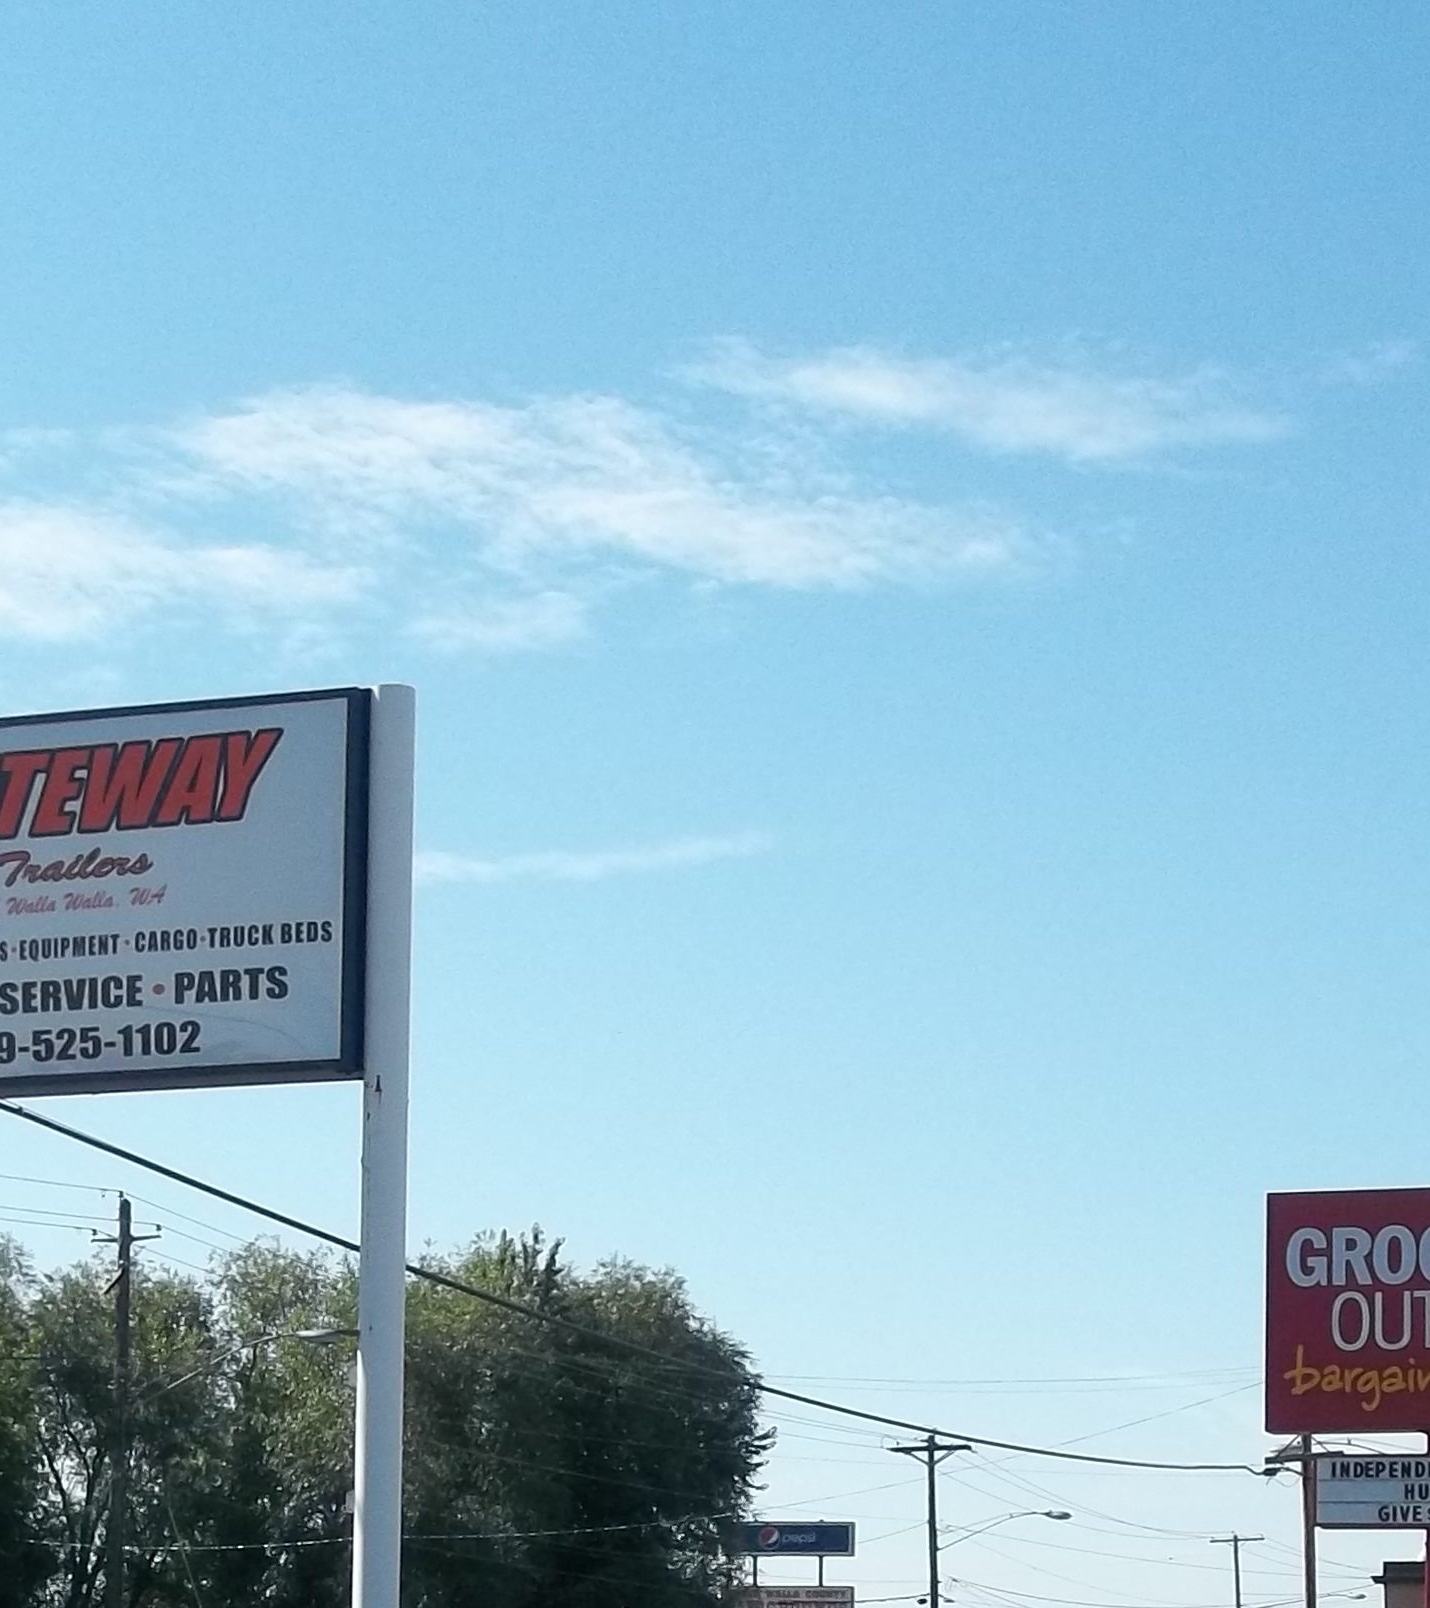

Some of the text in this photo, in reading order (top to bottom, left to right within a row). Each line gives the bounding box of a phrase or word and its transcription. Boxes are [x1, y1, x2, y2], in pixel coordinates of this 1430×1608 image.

[6, 895, 57, 916] Walla
[129, 883, 168, 907] WA
[19, 934, 120, 961] EQUIPMENT
[134, 928, 198, 952] CARGO
[207, 923, 274, 948] TRUCK
[280, 921, 333, 944] BEDS
[174, 966, 289, 1004] PARTS
[1378, 1505, 1422, 1522] GIVE
[781, 1531, 816, 1545] pepsi
